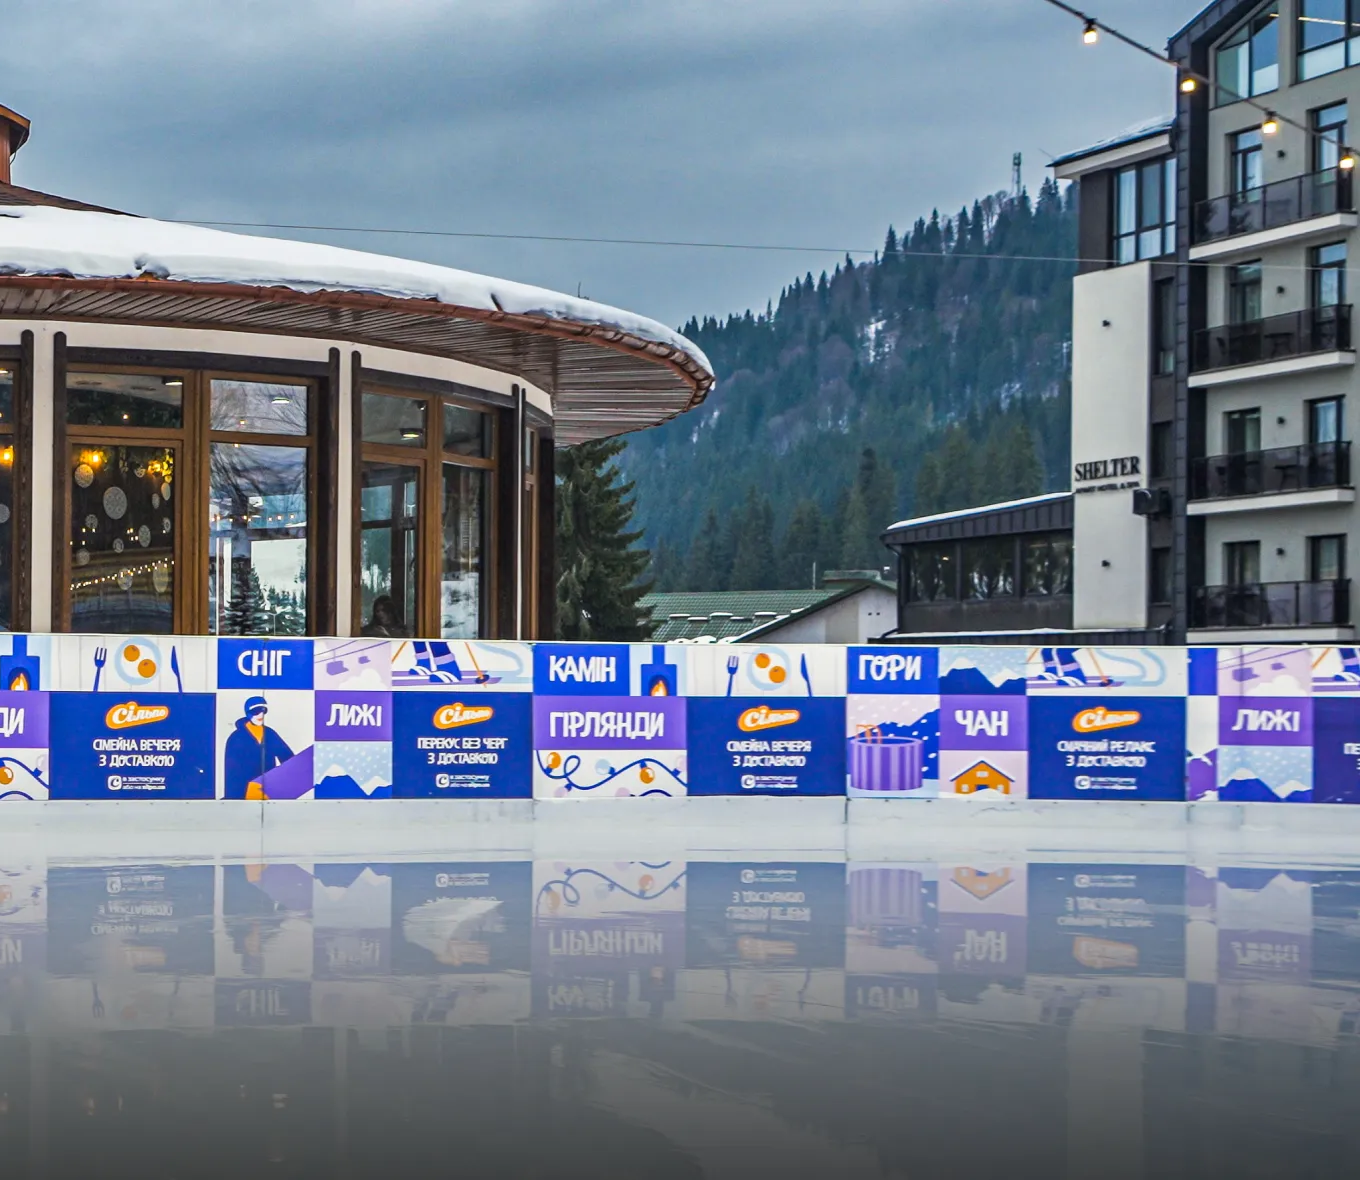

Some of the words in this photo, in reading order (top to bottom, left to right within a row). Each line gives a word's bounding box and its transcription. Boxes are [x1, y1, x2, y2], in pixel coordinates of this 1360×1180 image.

[1074, 456, 1141, 482] SHELTER
[238, 650, 290, 676] СНІГ
[550, 656, 615, 682] КАМІН
[860, 655, 921, 680] ГОРИ
[113, 706, 165, 723] Сільпо
[326, 702, 382, 727] ЛИЖІ
[955, 710, 1008, 736] ЧАН
[1232, 710, 1299, 731] ЛИЖІ
[550, 712, 664, 739] ГІРЛЯНДИ
[93, 737, 138, 750] СІМЕЙНА
[140, 740, 180, 750] ВЕЧЕРЯ
[418, 738, 460, 749] ПЕРЕКУС
[462, 738, 481, 749] БЕЗ
[483, 738, 508, 749] ЧЕРГ
[100, 755, 106, 766] З
[109, 755, 174, 767] ДОСТАВКОЮ
[428, 753, 435, 763] З
[733, 756, 740, 766] З
[1067, 755, 1074, 766] З
